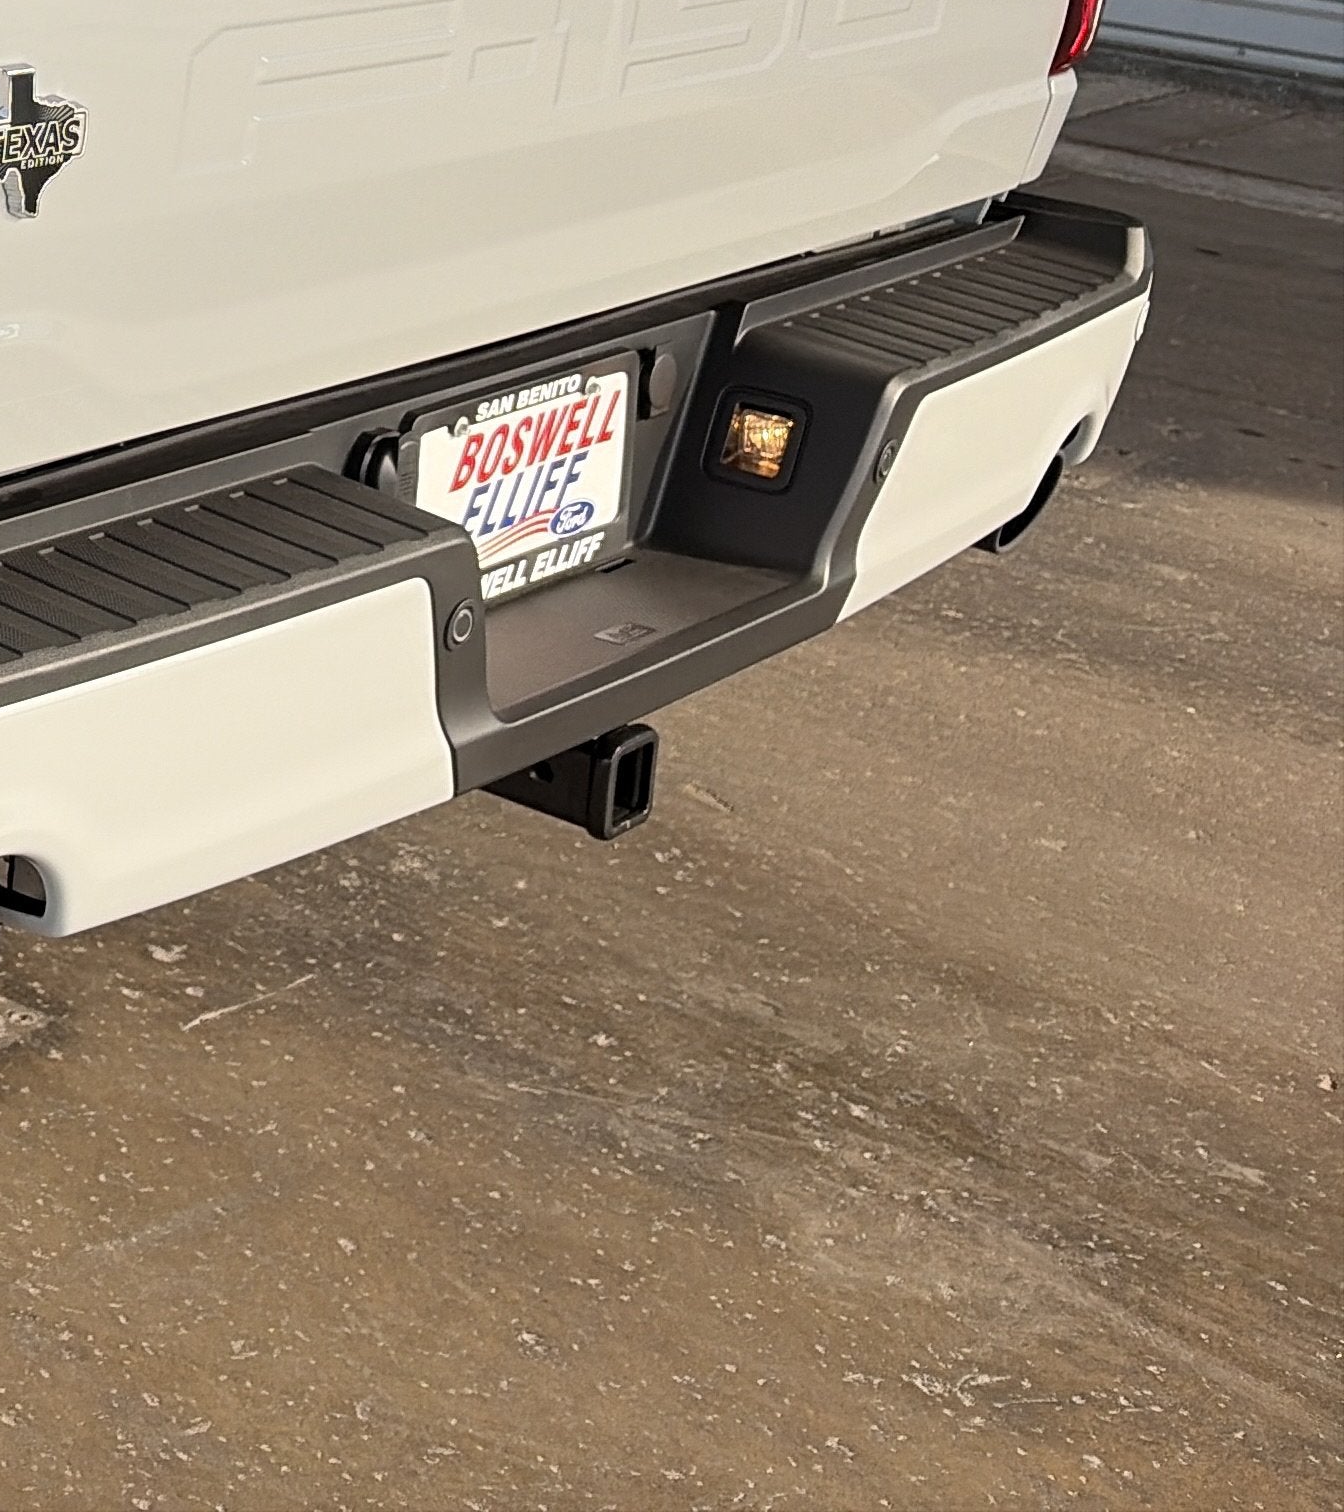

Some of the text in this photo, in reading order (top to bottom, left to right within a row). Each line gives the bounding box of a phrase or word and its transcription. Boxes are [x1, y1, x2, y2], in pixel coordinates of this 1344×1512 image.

[20, 154, 65, 170] EDITION
[475, 373, 582, 422] SAN BENITO
[448, 390, 621, 494] BOSWELL
[462, 450, 590, 538] ELLIFF
[557, 502, 590, 534] Ford
[529, 531, 605, 583] ELLIFF
